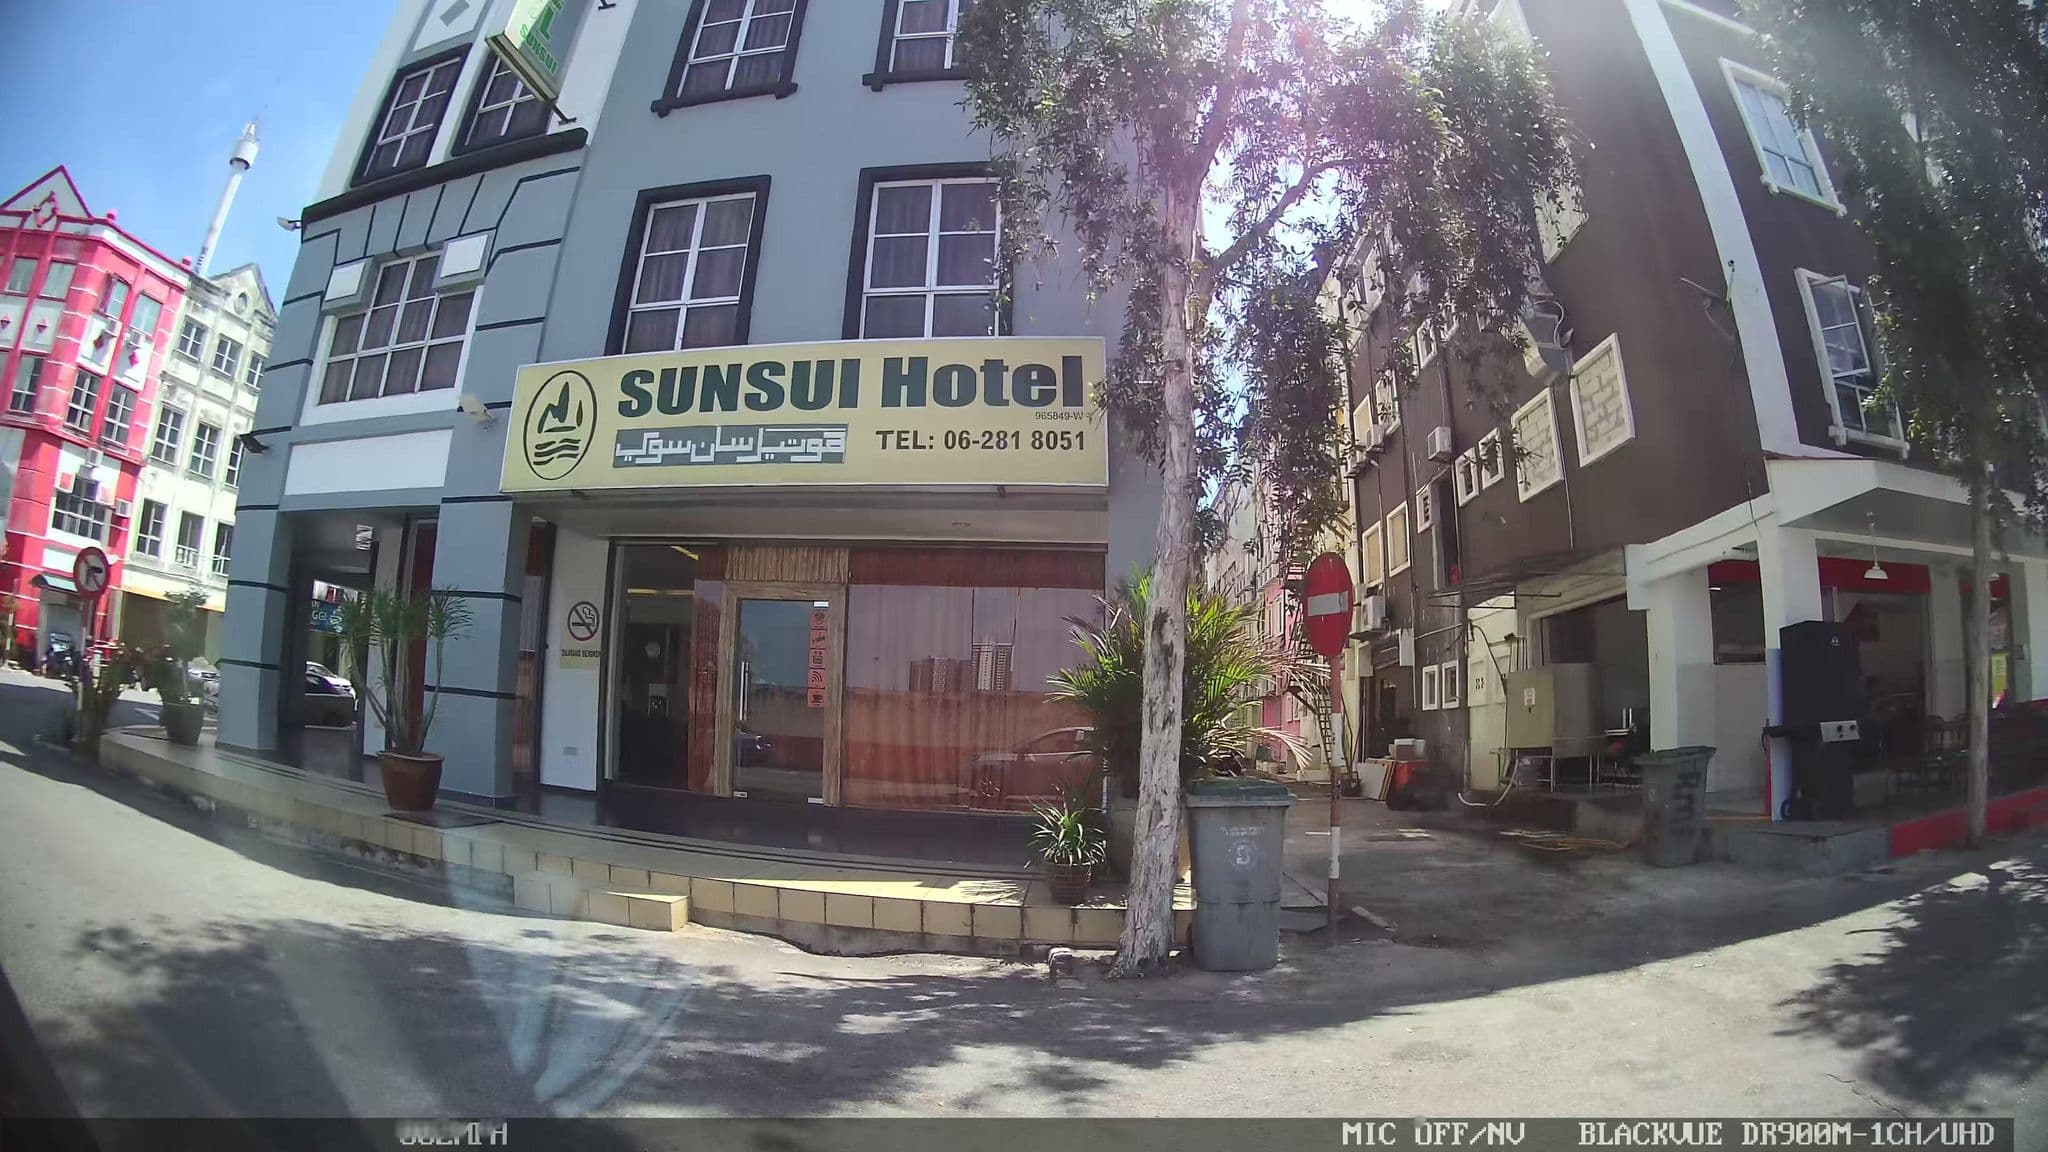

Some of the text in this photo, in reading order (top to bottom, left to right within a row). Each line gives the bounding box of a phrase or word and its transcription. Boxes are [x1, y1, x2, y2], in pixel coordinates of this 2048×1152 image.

[520, 24, 558, 74] SUNSUI
[618, 355, 1084, 418] SUNSUI Hotel
[875, 430, 1085, 451] TEL: 06-281 8051
